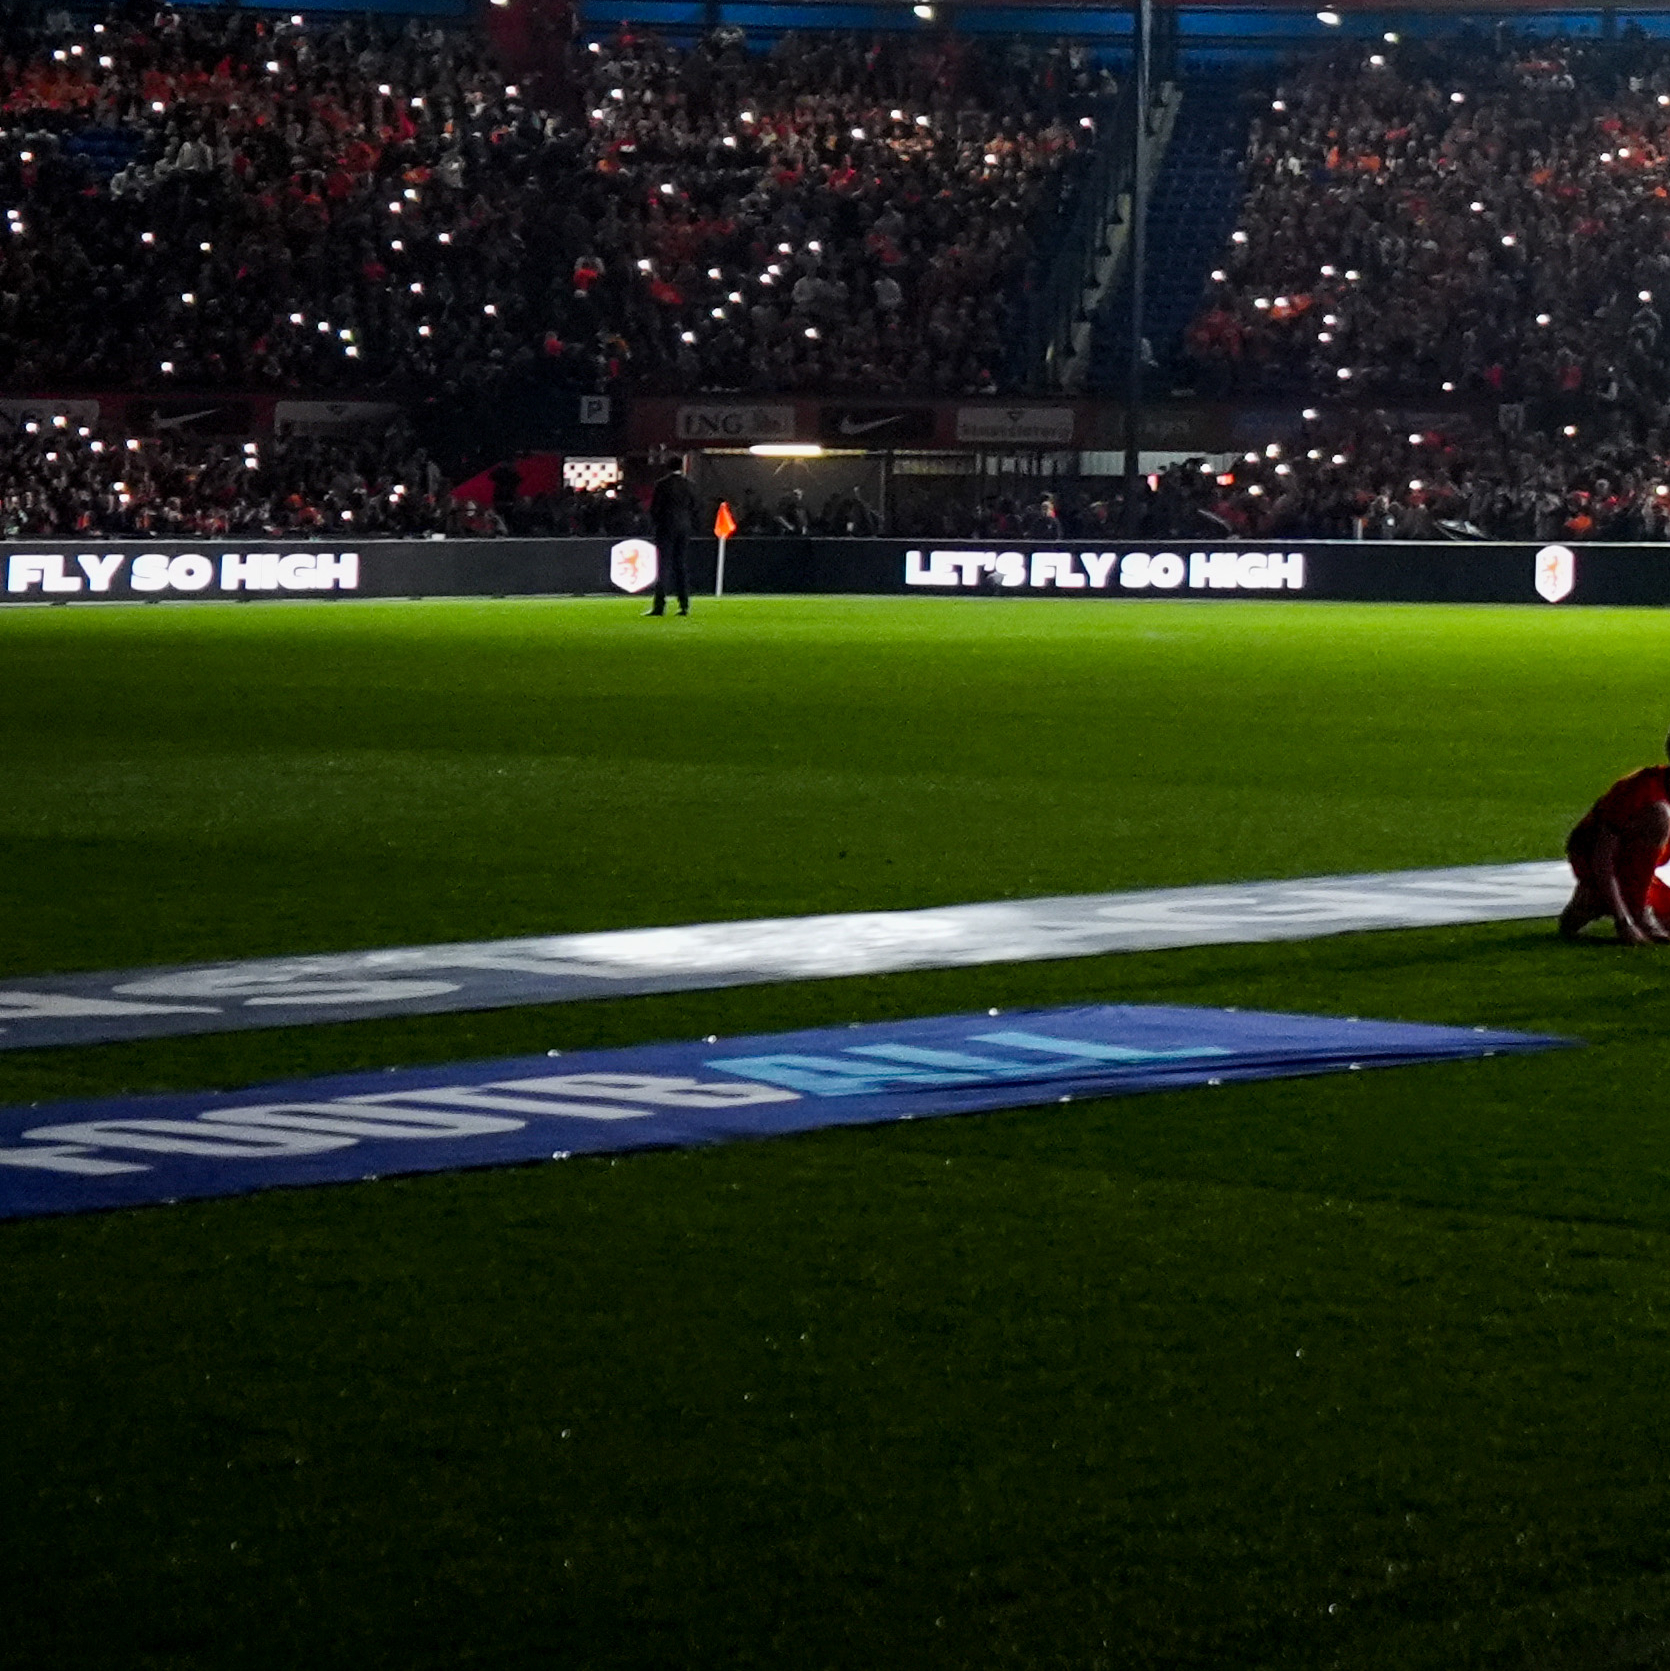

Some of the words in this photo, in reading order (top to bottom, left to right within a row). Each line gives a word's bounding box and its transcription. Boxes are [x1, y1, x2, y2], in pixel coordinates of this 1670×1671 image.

[685, 411, 743, 434] ING
[7, 554, 124, 593] FLY
[130, 553, 213, 591] SO
[220, 553, 358, 590] HIGH
[905, 550, 1026, 587] LET'S
[1030, 552, 1116, 588] FLY
[1119, 552, 1185, 589] SO
[1189, 553, 1305, 590] HIGH
